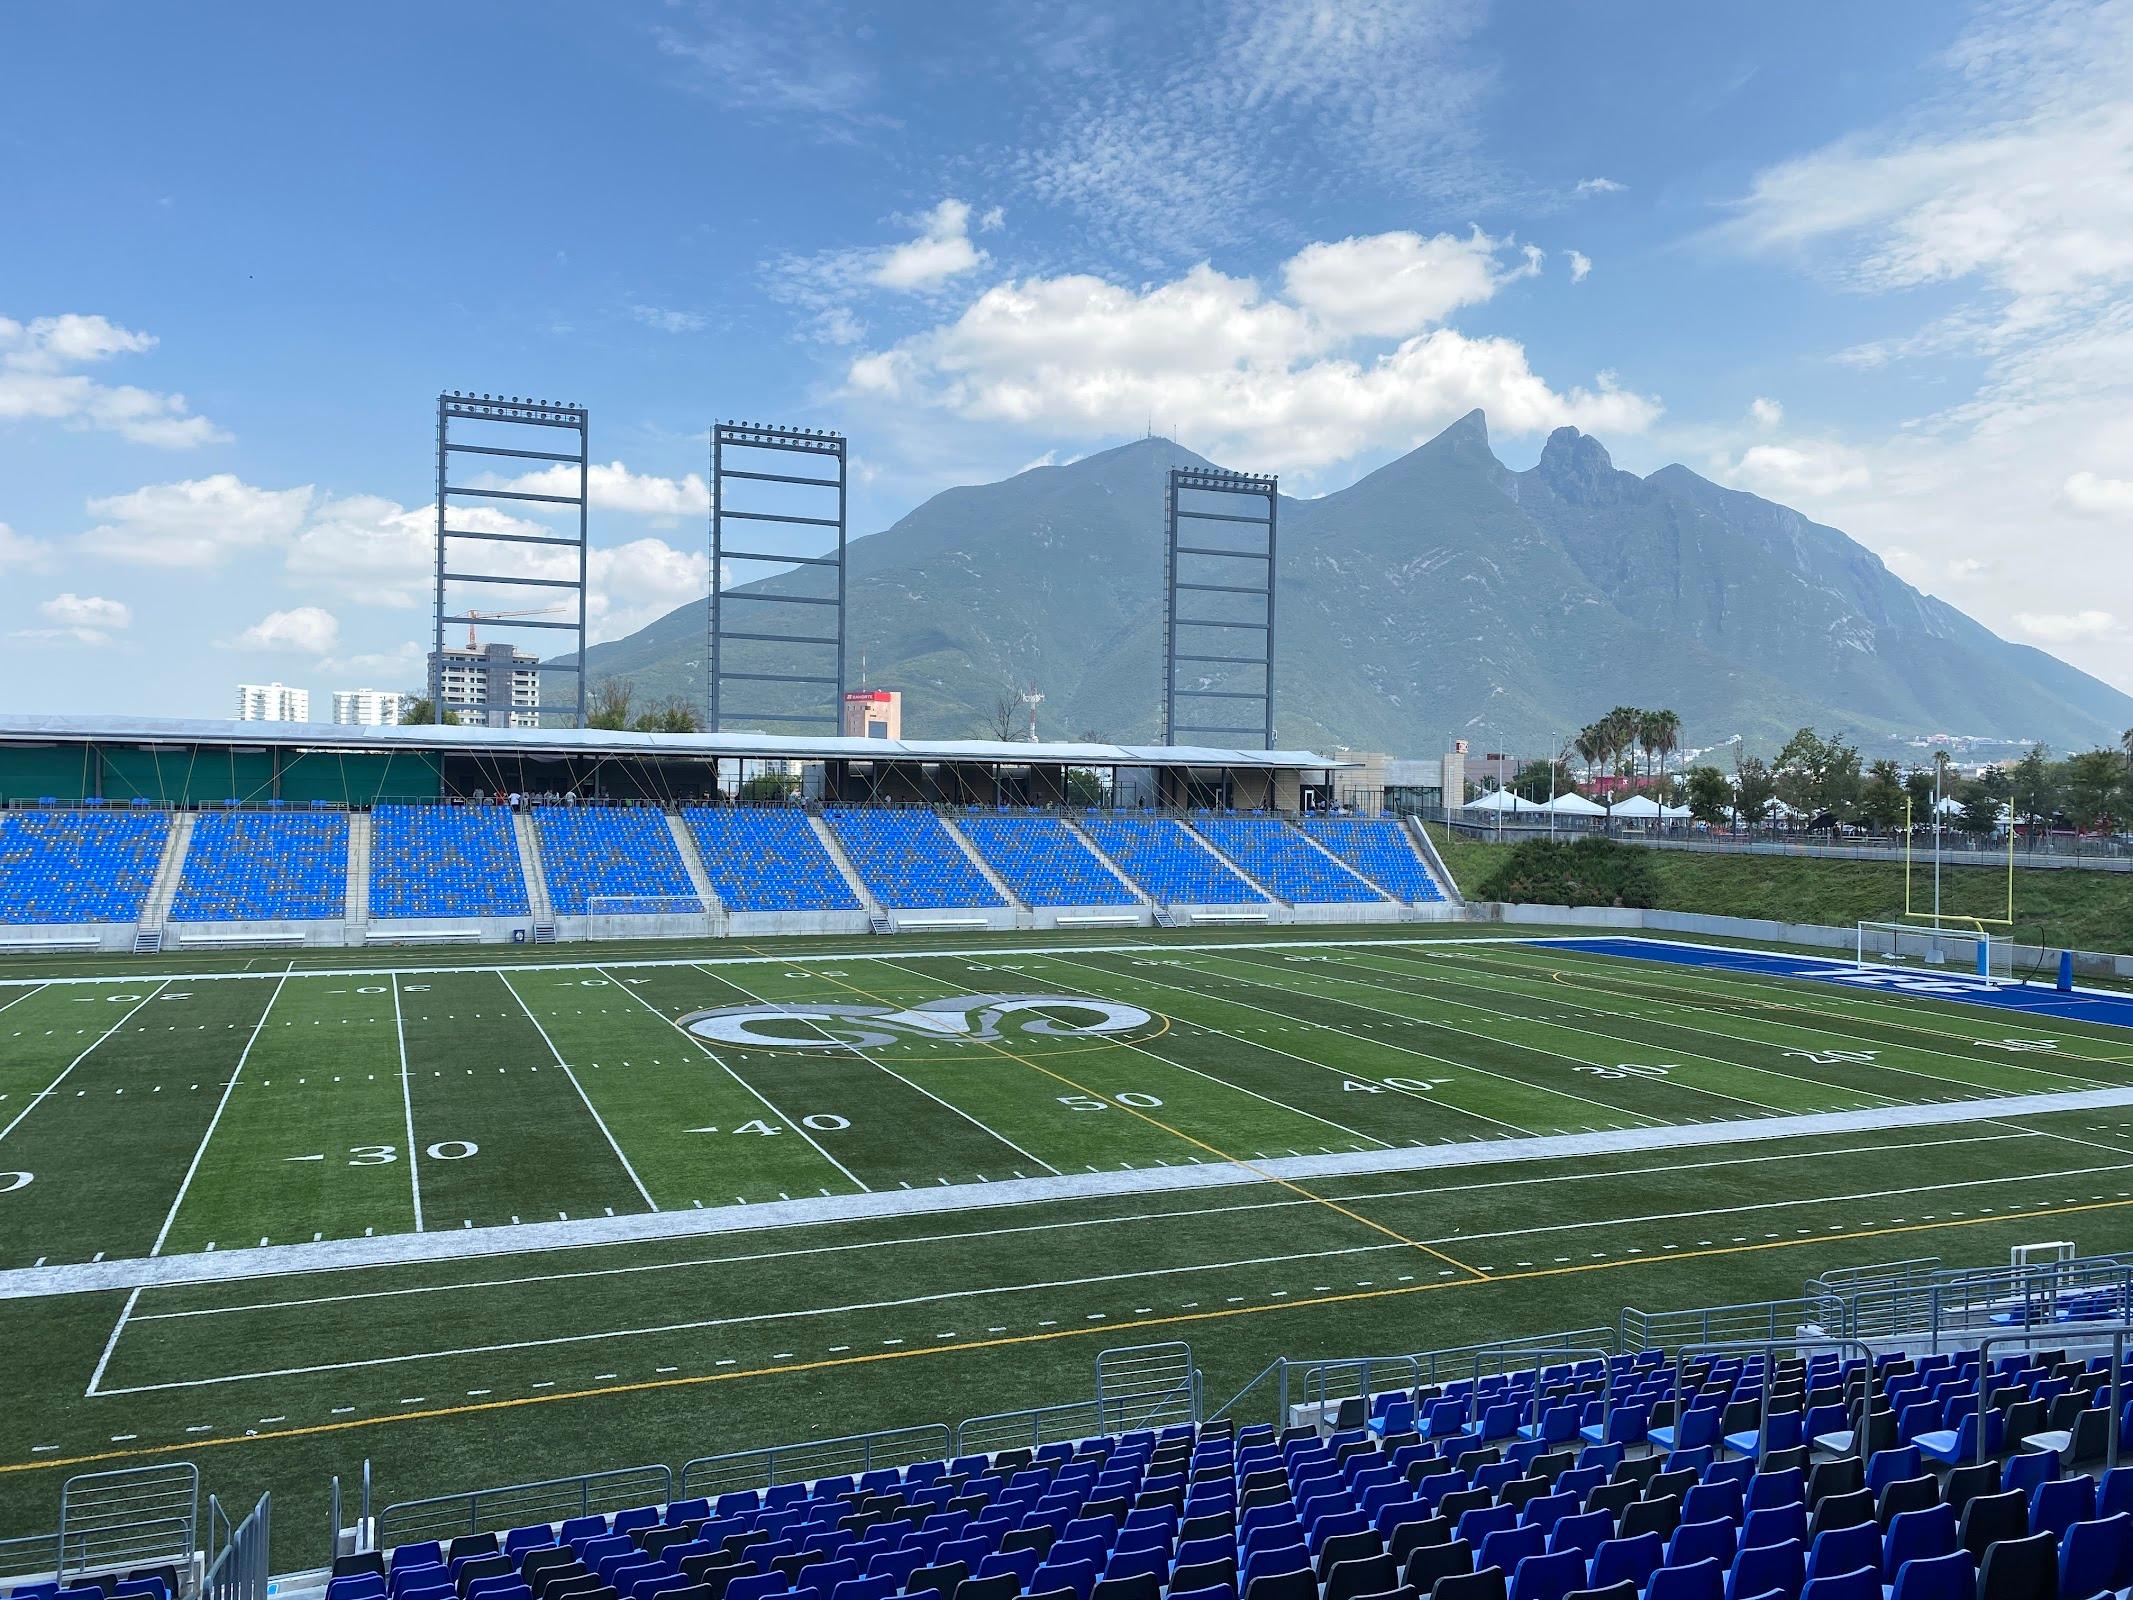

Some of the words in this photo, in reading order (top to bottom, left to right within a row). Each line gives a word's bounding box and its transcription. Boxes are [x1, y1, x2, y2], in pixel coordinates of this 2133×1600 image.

[1791, 968, 2003, 993] TEC
[1781, 1050, 1875, 1064] 20
[1572, 1063, 1669, 1079] 30
[1343, 1077, 1433, 1094] 40
[1056, 1093, 1163, 1111] 50
[732, 1114, 851, 1136] 40
[349, 1141, 479, 1165] 30
